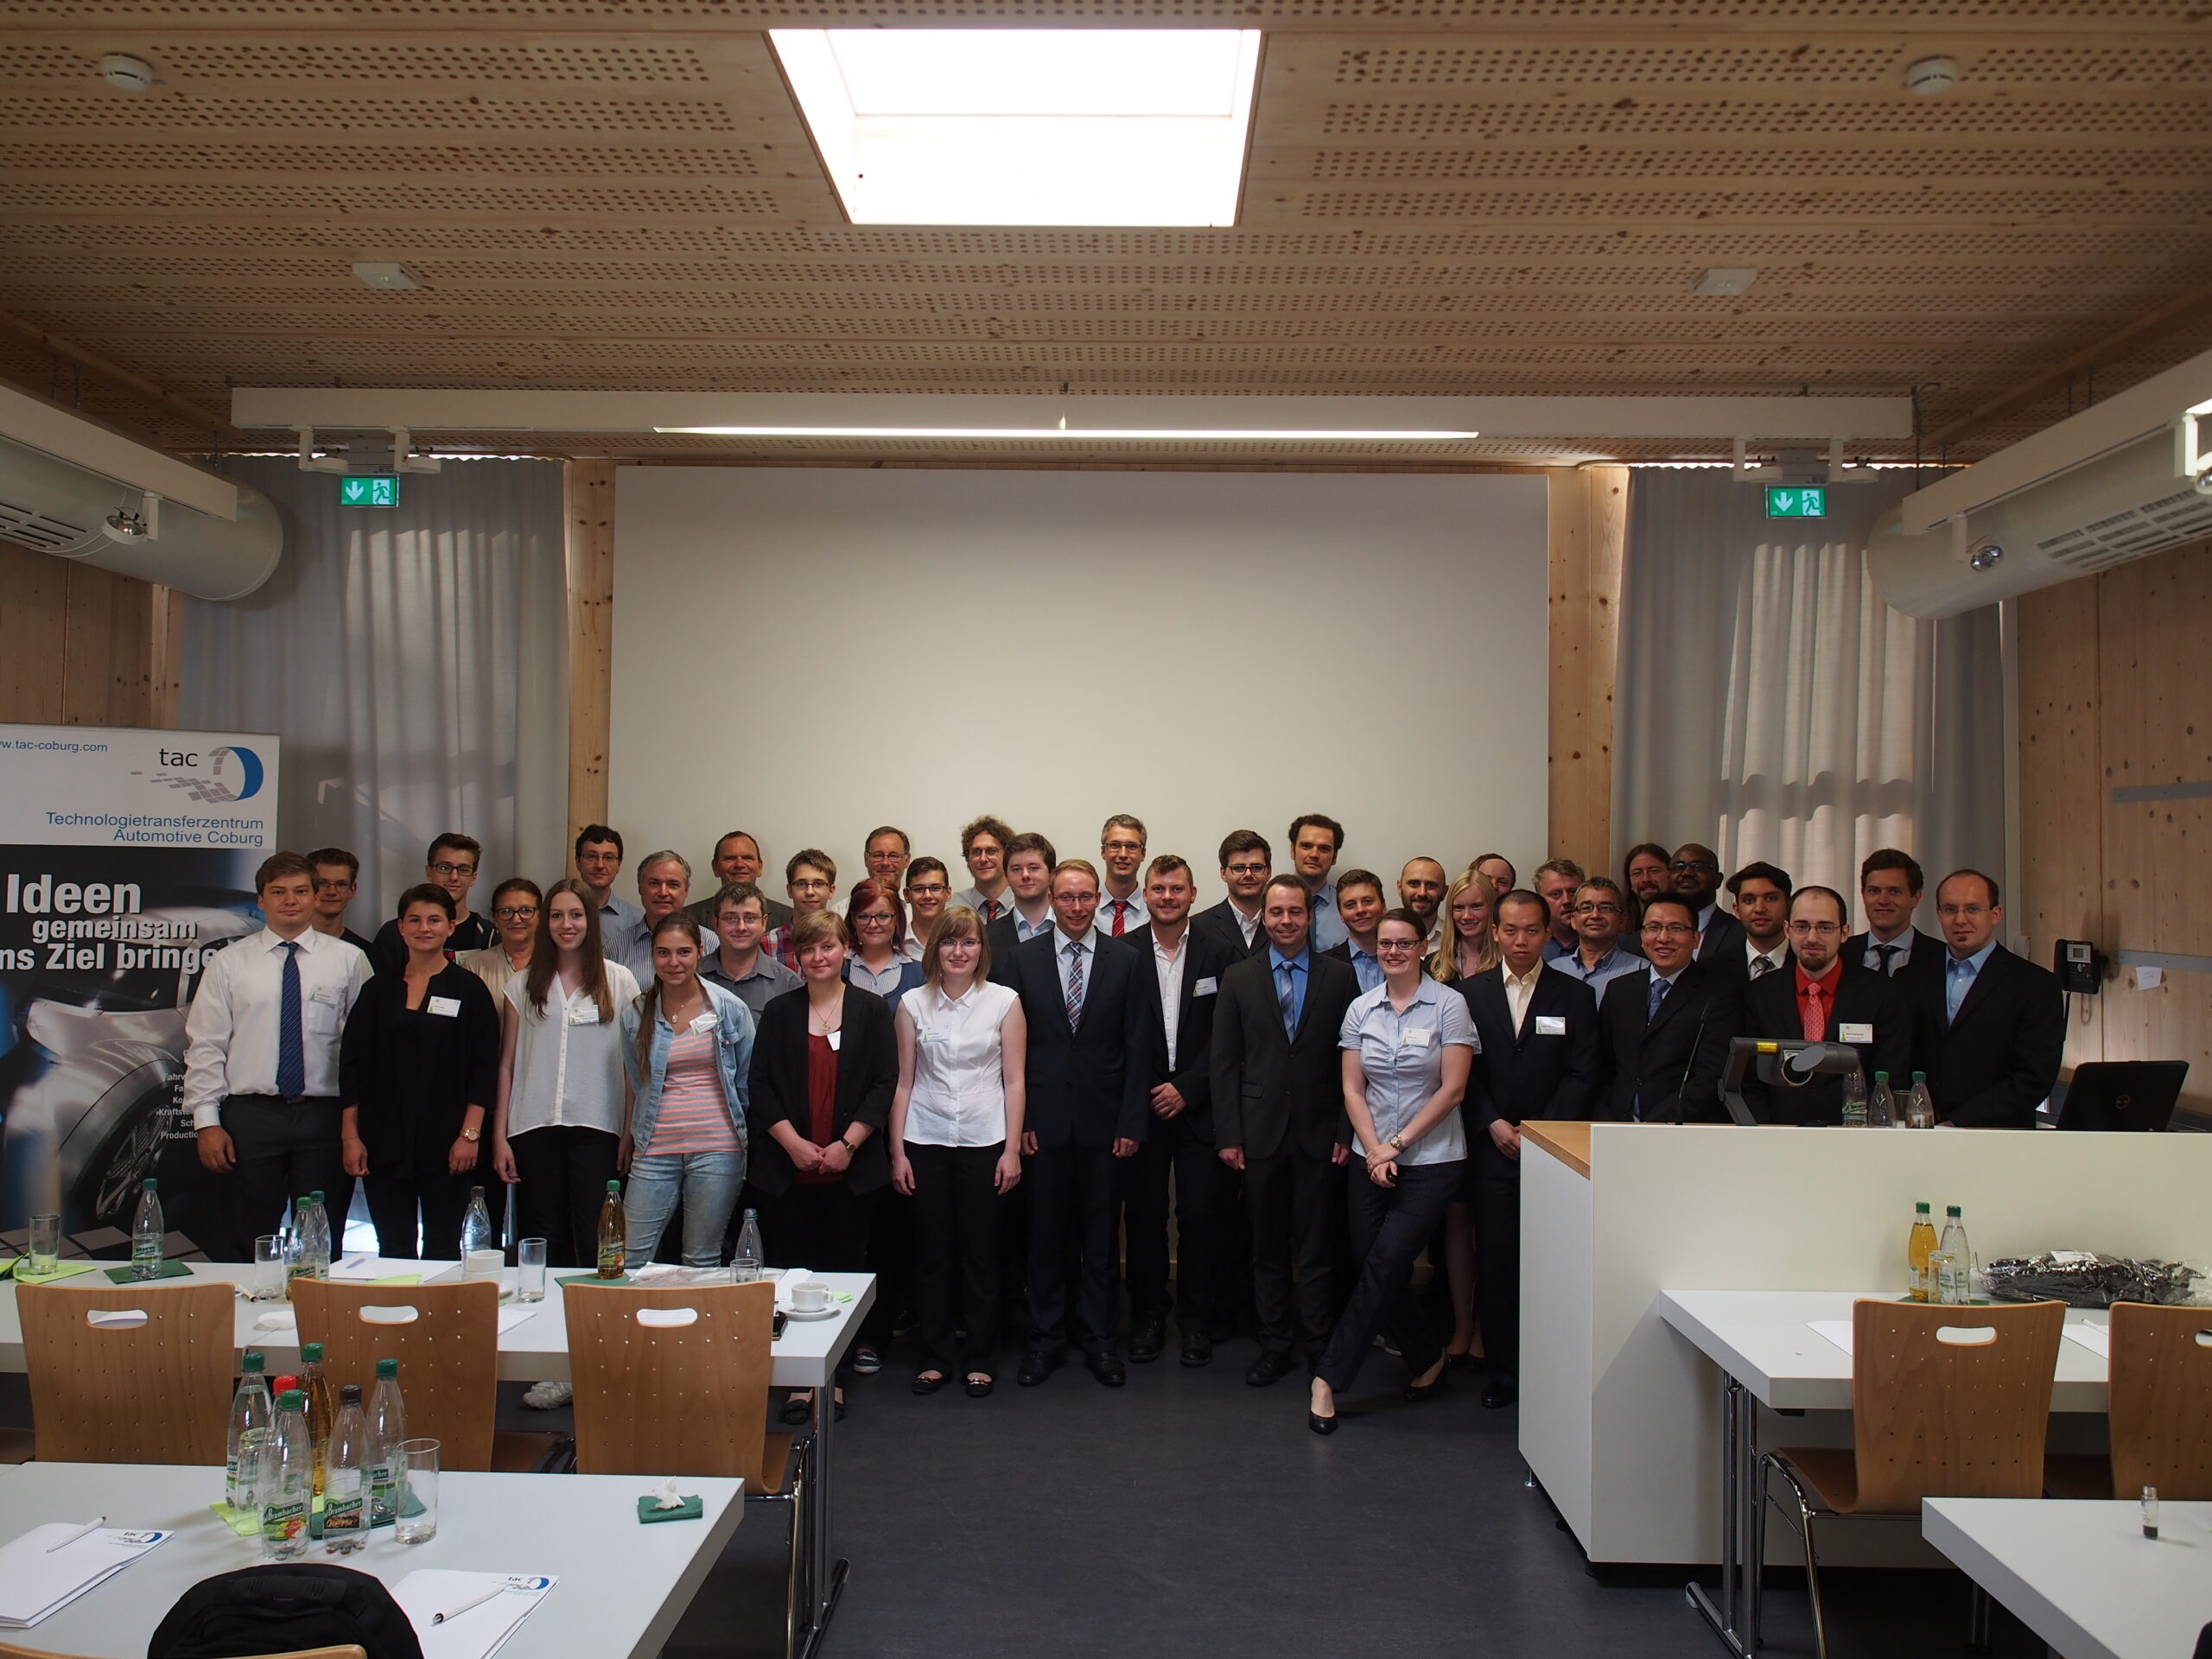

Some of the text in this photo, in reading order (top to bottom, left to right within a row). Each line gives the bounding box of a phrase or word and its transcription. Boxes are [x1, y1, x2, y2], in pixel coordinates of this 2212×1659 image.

[159, 748, 198, 767] tac
[46, 811, 264, 830] Technologietransferzentrum
[113, 829, 263, 846] Automotive Coburg
[6, 874, 142, 913] Ideen
[32, 915, 198, 944] gemeinsam
[46, 943, 105, 969] Ziel
[269, 1505, 302, 1521] Brambacher
[329, 1501, 361, 1516] Brambacher
